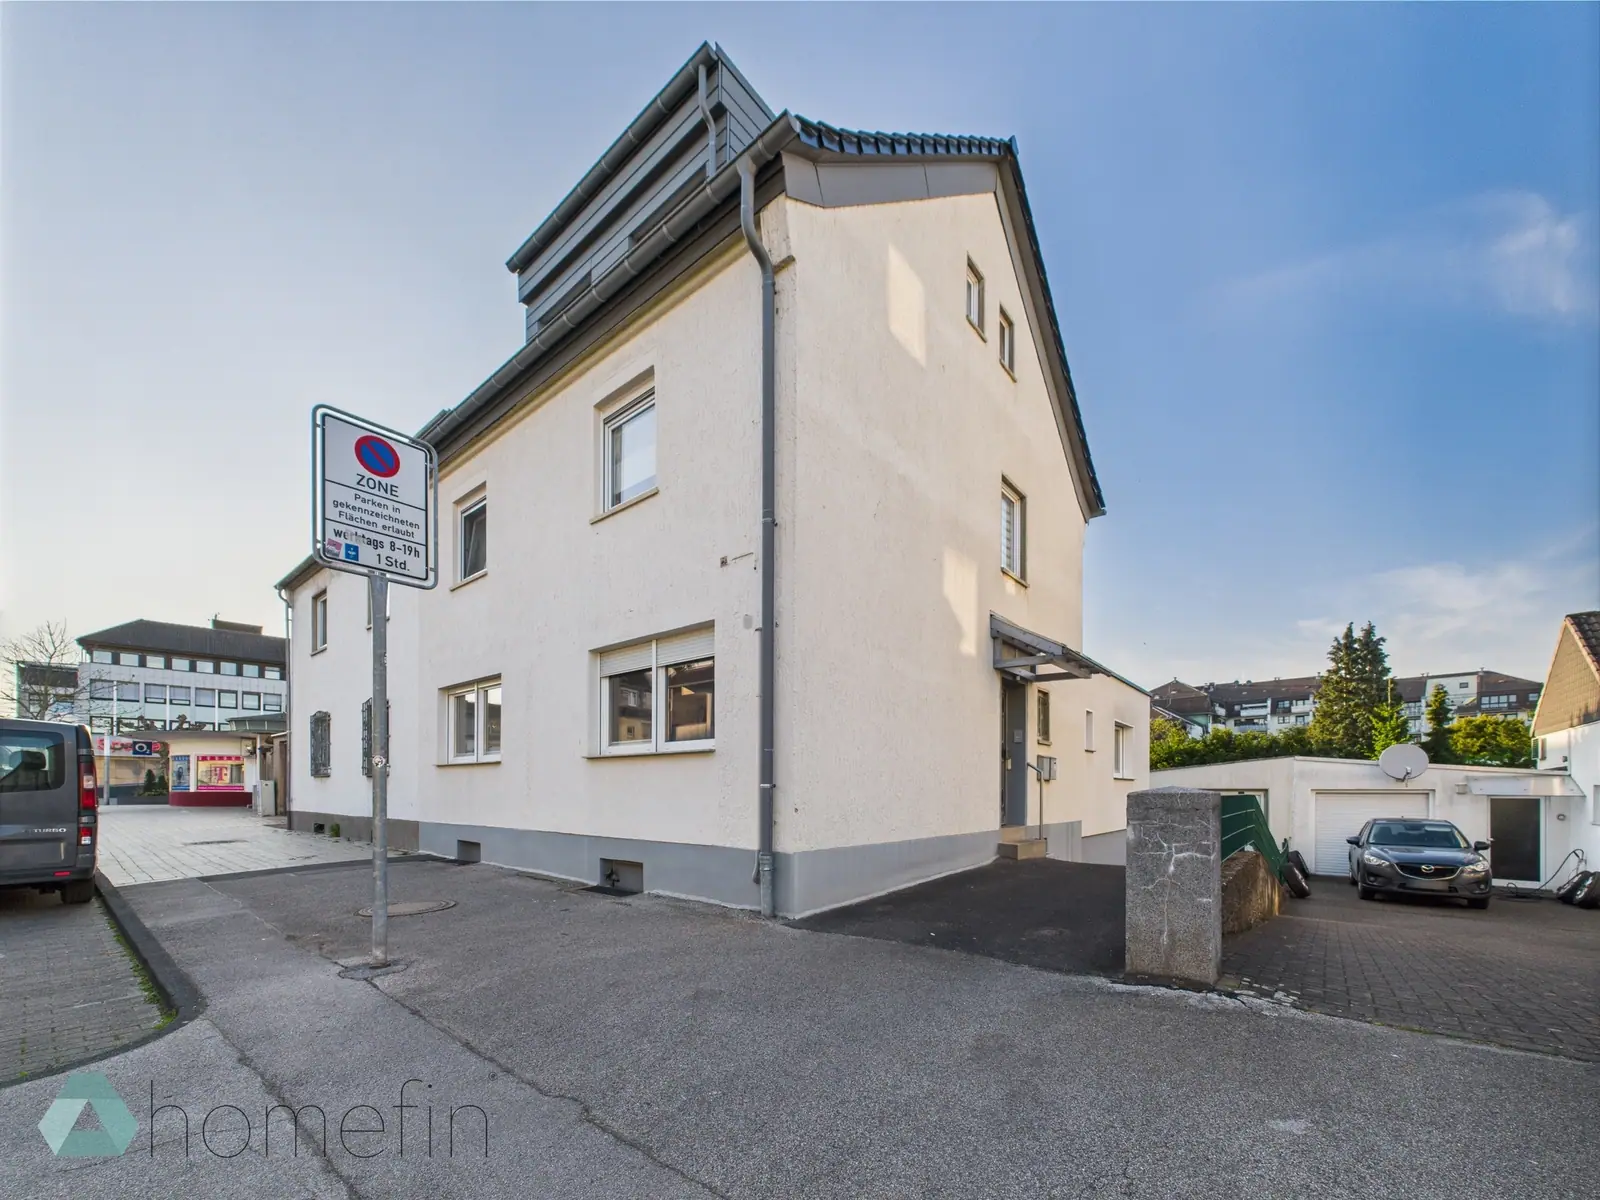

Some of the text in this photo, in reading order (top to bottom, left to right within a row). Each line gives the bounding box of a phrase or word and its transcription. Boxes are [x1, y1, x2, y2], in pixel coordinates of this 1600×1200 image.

[356, 473, 399, 497] ZONE
[332, 500, 420, 530] gekennzeichneten
[354, 493, 401, 514] Parken in
[338, 511, 415, 539] Flächen erlaubt
[376, 554, 411, 572] 1 Std.
